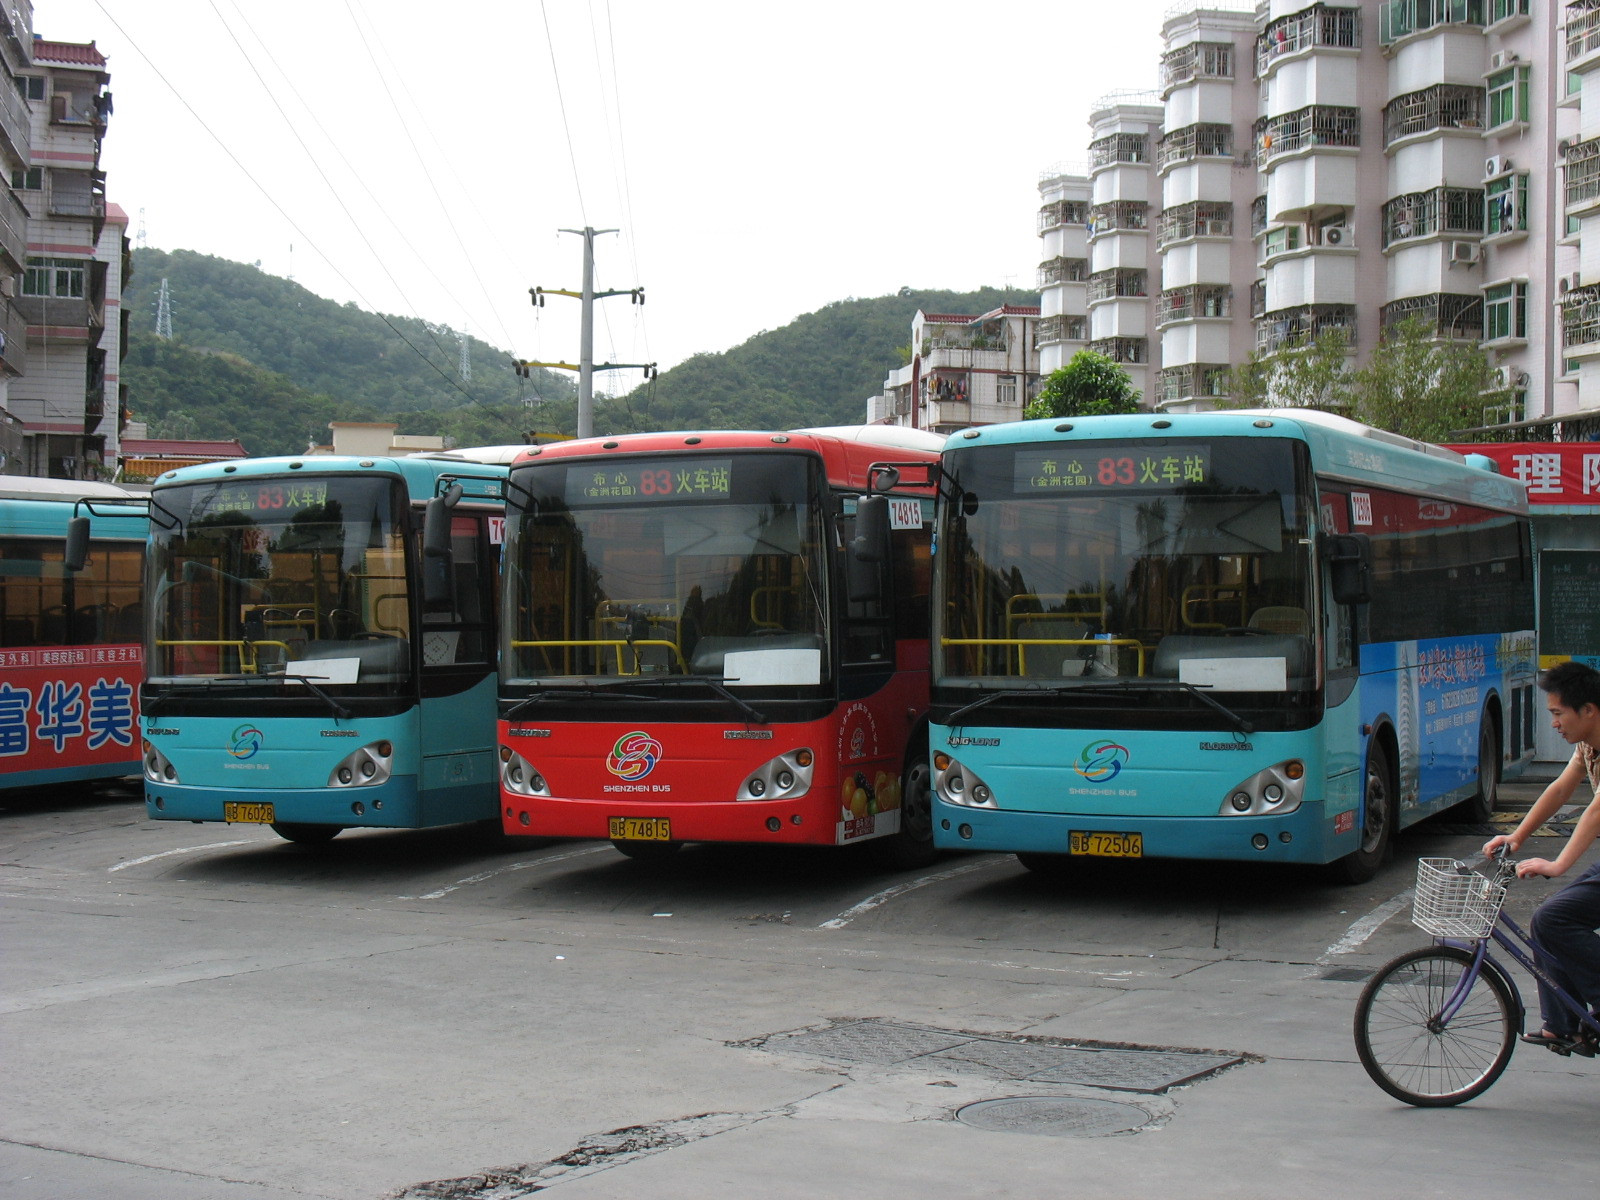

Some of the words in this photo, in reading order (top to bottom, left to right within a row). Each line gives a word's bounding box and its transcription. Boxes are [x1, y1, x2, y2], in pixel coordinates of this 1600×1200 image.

[593, 472, 628, 486] 布心
[1042, 460, 1083, 475] 布心
[1097, 457, 1136, 485] 83
[1140, 455, 1204, 484] 火车站
[640, 469, 673, 496] 83
[676, 467, 729, 493] 火车站
[257, 486, 284, 509] 83
[287, 484, 327, 508] 火车站
[891, 502, 920, 525] 74815
[97, 648, 136, 662] 美容牙科
[603, 784, 650, 793] SHENZHEN
[652, 784, 671, 792] BUS
[1069, 787, 1117, 796] SHENZHEN
